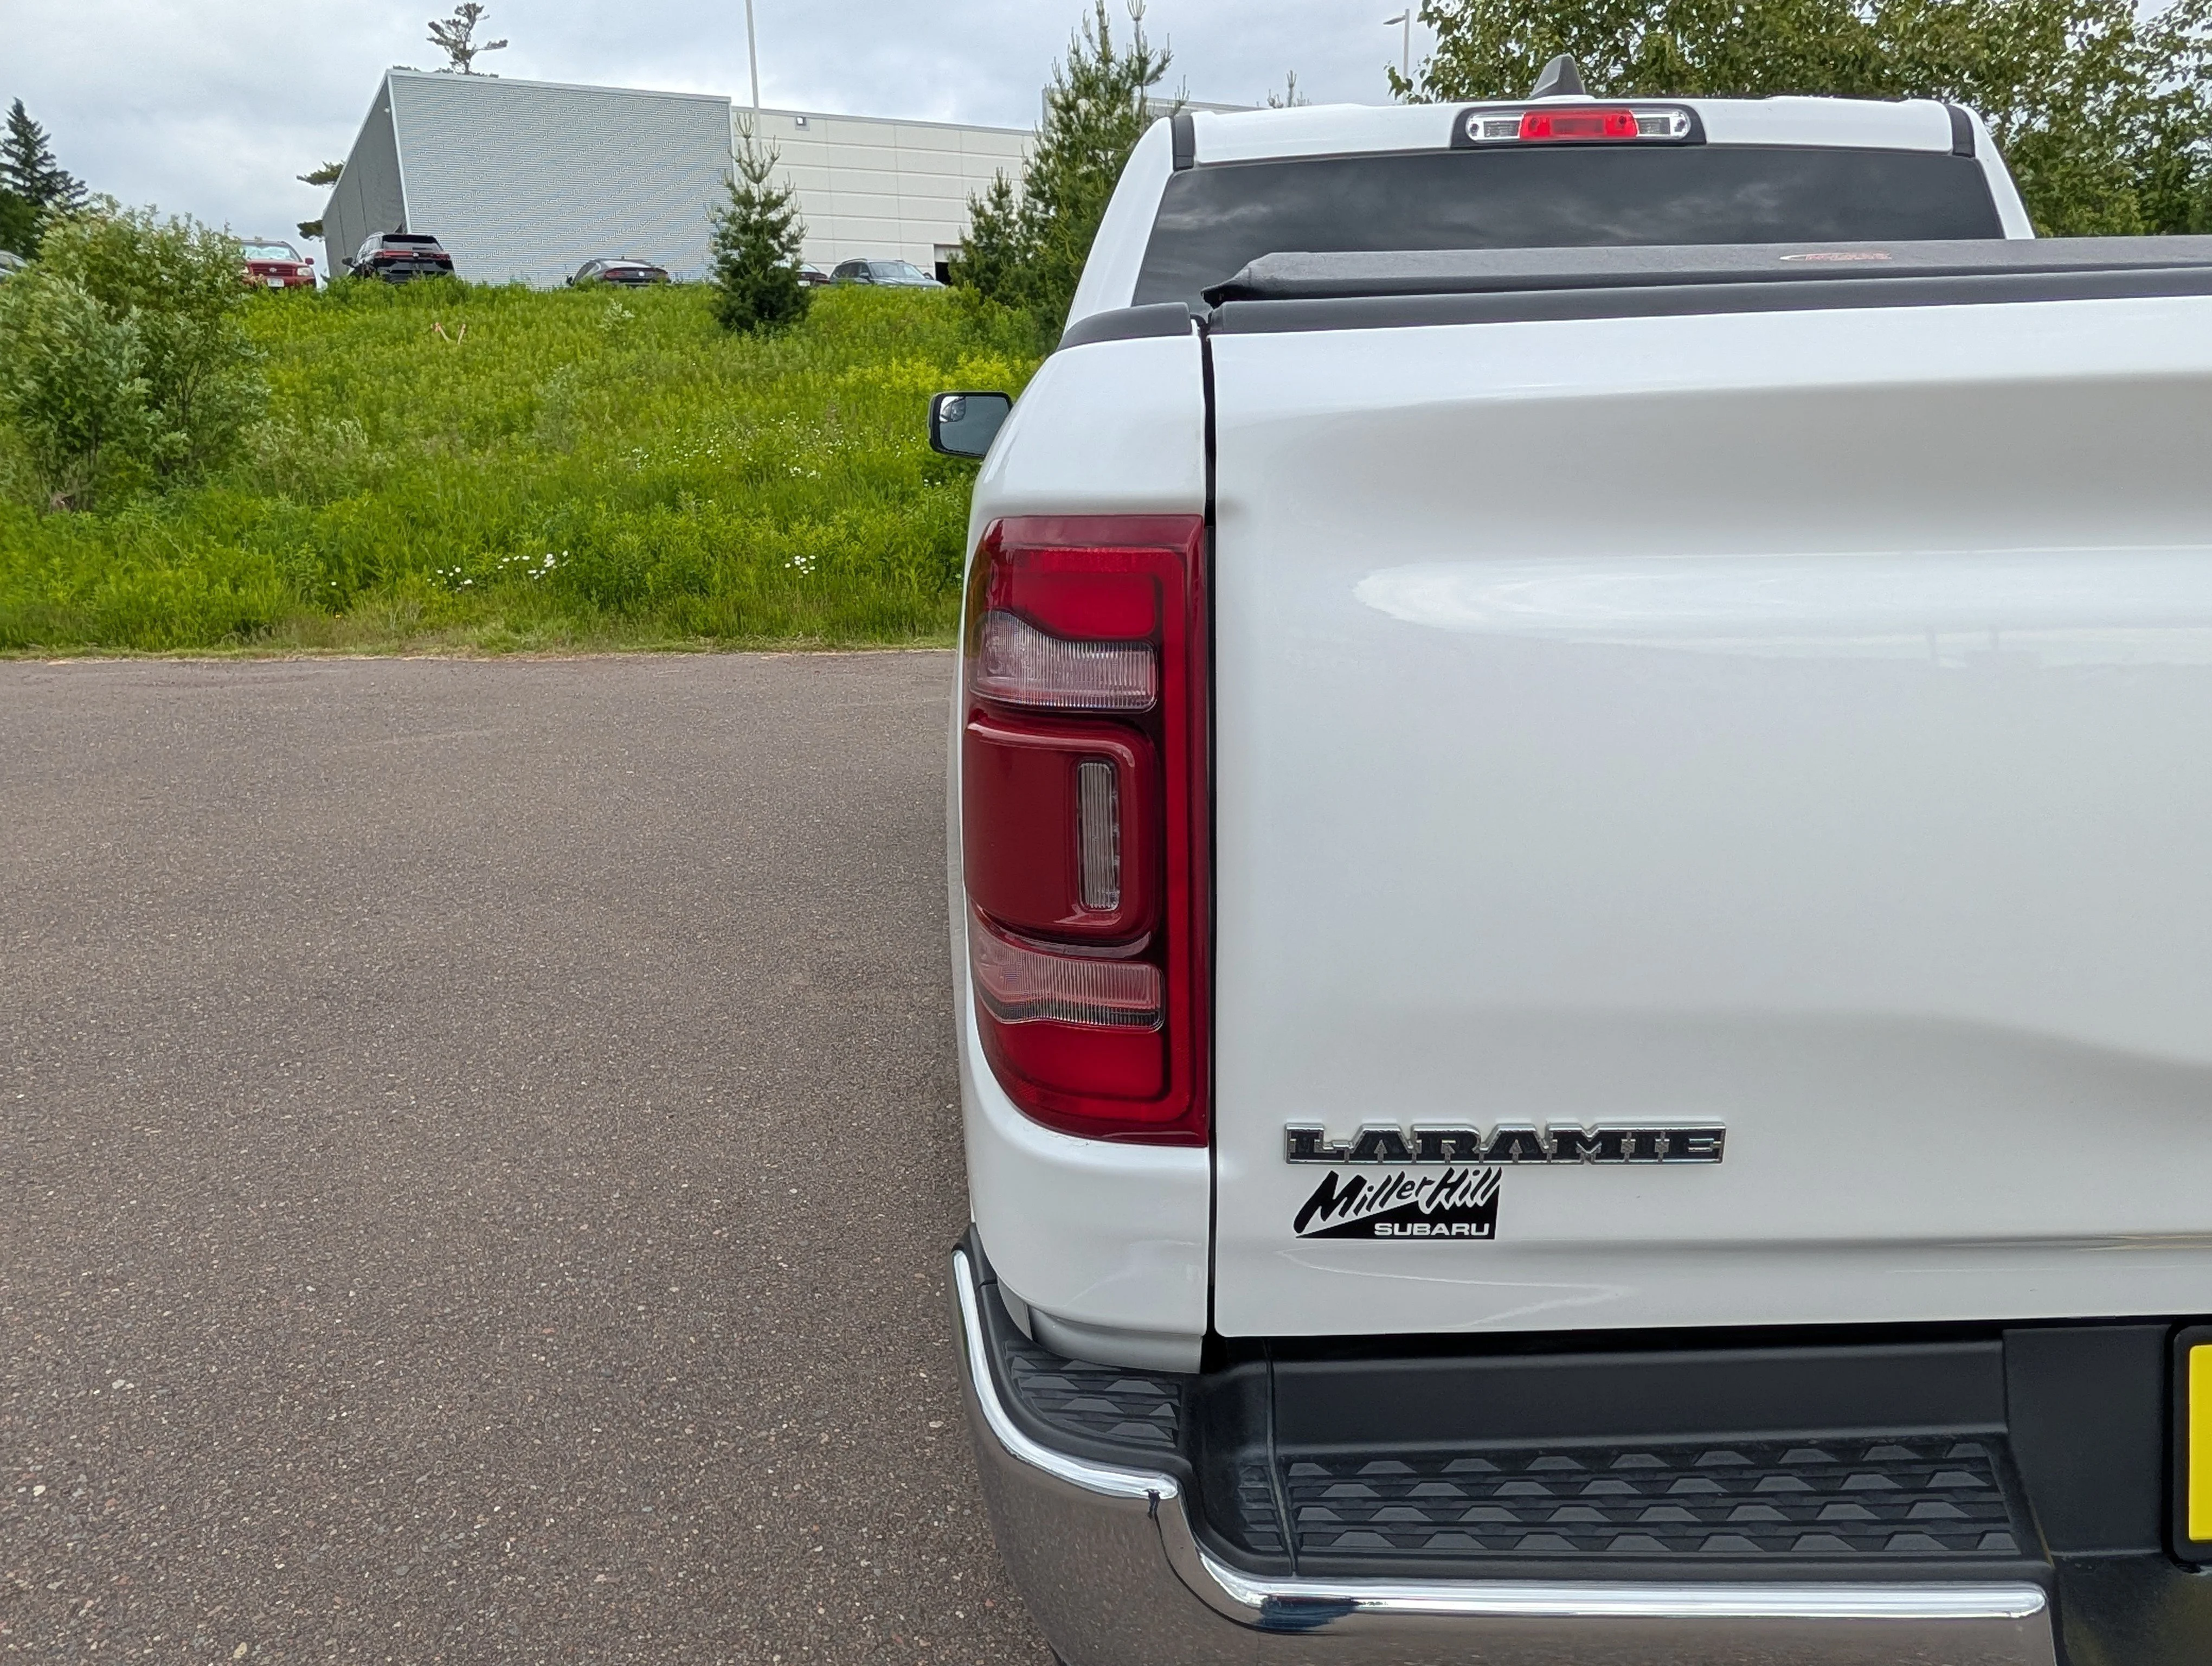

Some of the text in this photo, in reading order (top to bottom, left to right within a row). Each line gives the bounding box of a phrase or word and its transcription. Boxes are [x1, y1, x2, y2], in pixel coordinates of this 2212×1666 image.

[1285, 1124, 1725, 1164] LARAMIE
[1294, 1167, 1502, 1234] Miller Hill
[1374, 1223, 1490, 1236] SUBARU
